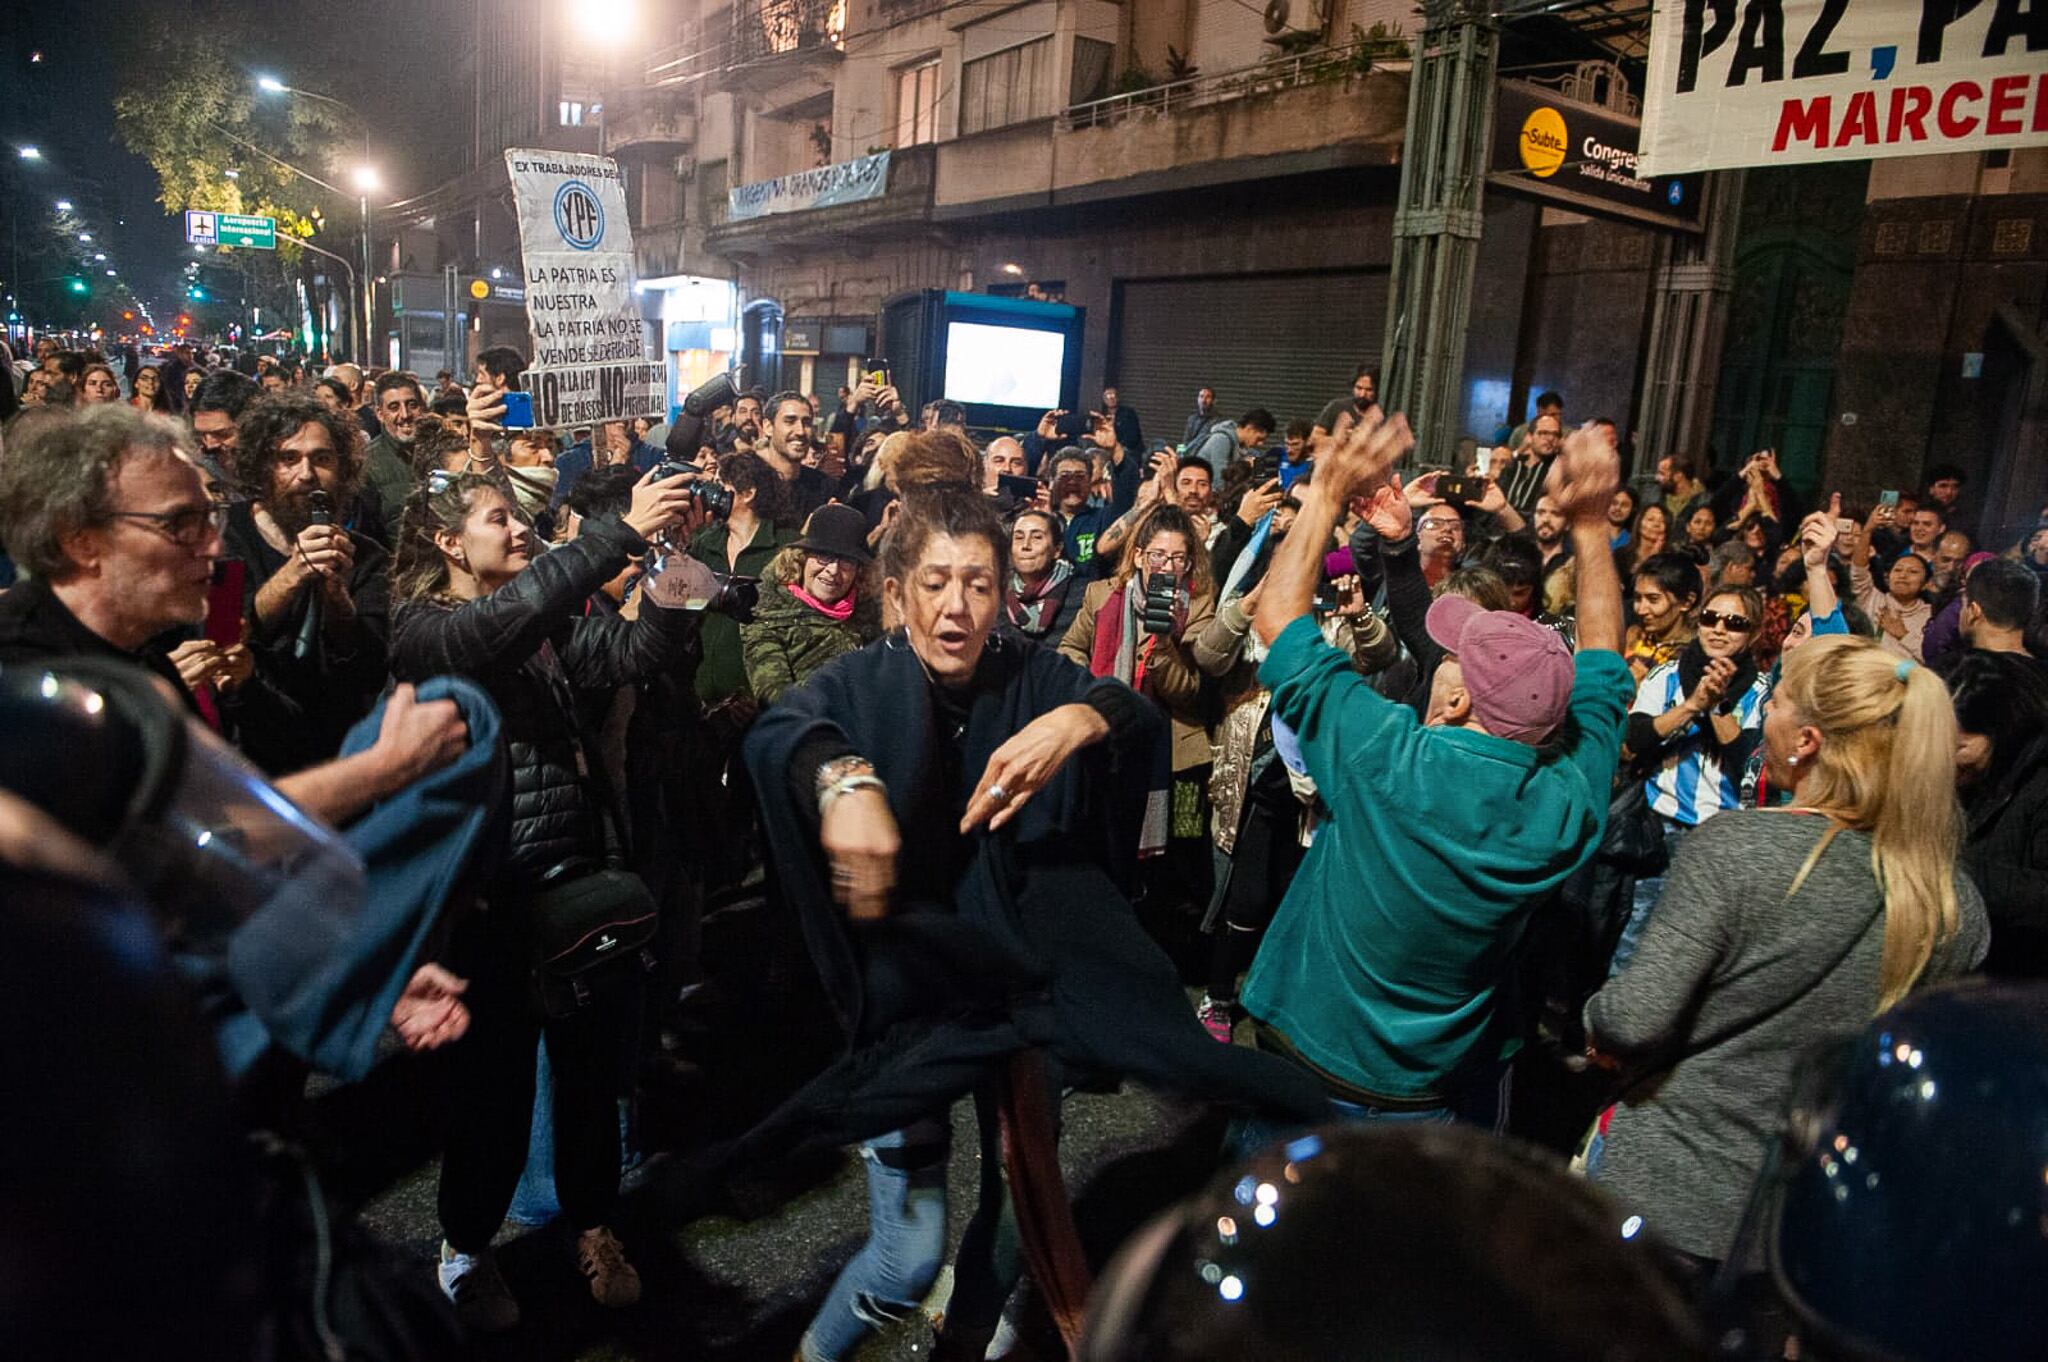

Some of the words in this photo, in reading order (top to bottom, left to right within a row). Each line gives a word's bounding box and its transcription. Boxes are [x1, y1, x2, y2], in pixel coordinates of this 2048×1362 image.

[1529, 127, 1565, 150] Subte
[514, 162, 529, 173] EX
[533, 162, 603, 177] TRABAJADORES
[1580, 164, 1604, 180] Salida
[562, 192, 597, 240] YPF
[529, 268, 547, 284] LA
[551, 268, 598, 283] PATRIA
[602, 268, 617, 284] ES
[533, 294, 598, 311] NUESTRA
[536, 320, 555, 338] LA
[558, 320, 605, 337] PATRIA
[607, 318, 627, 335] NO
[629, 318, 642, 334] SE
[539, 347, 586, 366] VENDE
[559, 371, 566, 393] A
[567, 370, 579, 392] LA
[580, 369, 596, 391] LEY
[599, 366, 625, 418] NO
[560, 402, 573, 424] DE
[574, 400, 602, 422] BASES
